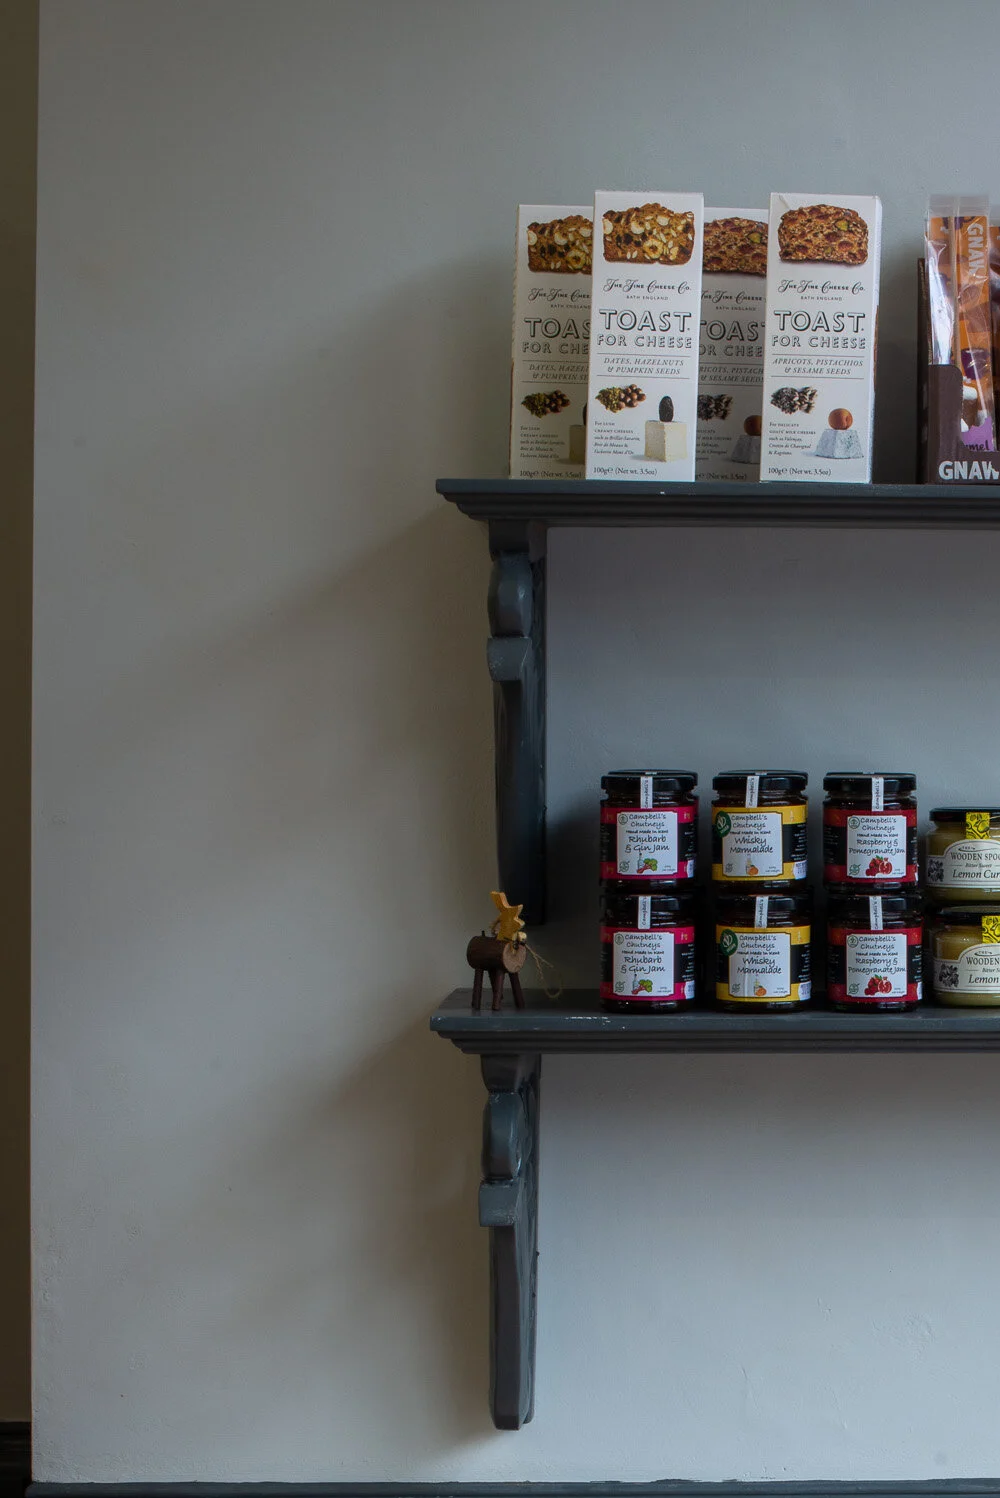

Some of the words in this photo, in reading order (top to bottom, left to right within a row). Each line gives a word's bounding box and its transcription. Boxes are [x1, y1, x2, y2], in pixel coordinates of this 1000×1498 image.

[966, 223, 986, 274] GNAW
[597, 334, 627, 346] FOR
[634, 335, 692, 348] CHEESE
[772, 335, 801, 347] FOR
[808, 336, 866, 349] CHEESE
[939, 461, 999, 480] GNAW
[862, 825, 895, 833] Chutneys
[629, 835, 666, 843] Rhubarb
[735, 836, 767, 846] Whisky
[857, 839, 892, 848] Raspberry
[730, 845, 773, 853] Marmalade
[849, 847, 894, 856] Pomegranate
[953, 869, 982, 879] Lemon
[742, 957, 775, 967] Whisky
[966, 957, 1000, 965] WOODEN
[737, 965, 782, 974] Marmalade
[969, 974, 999, 983] Lemon
